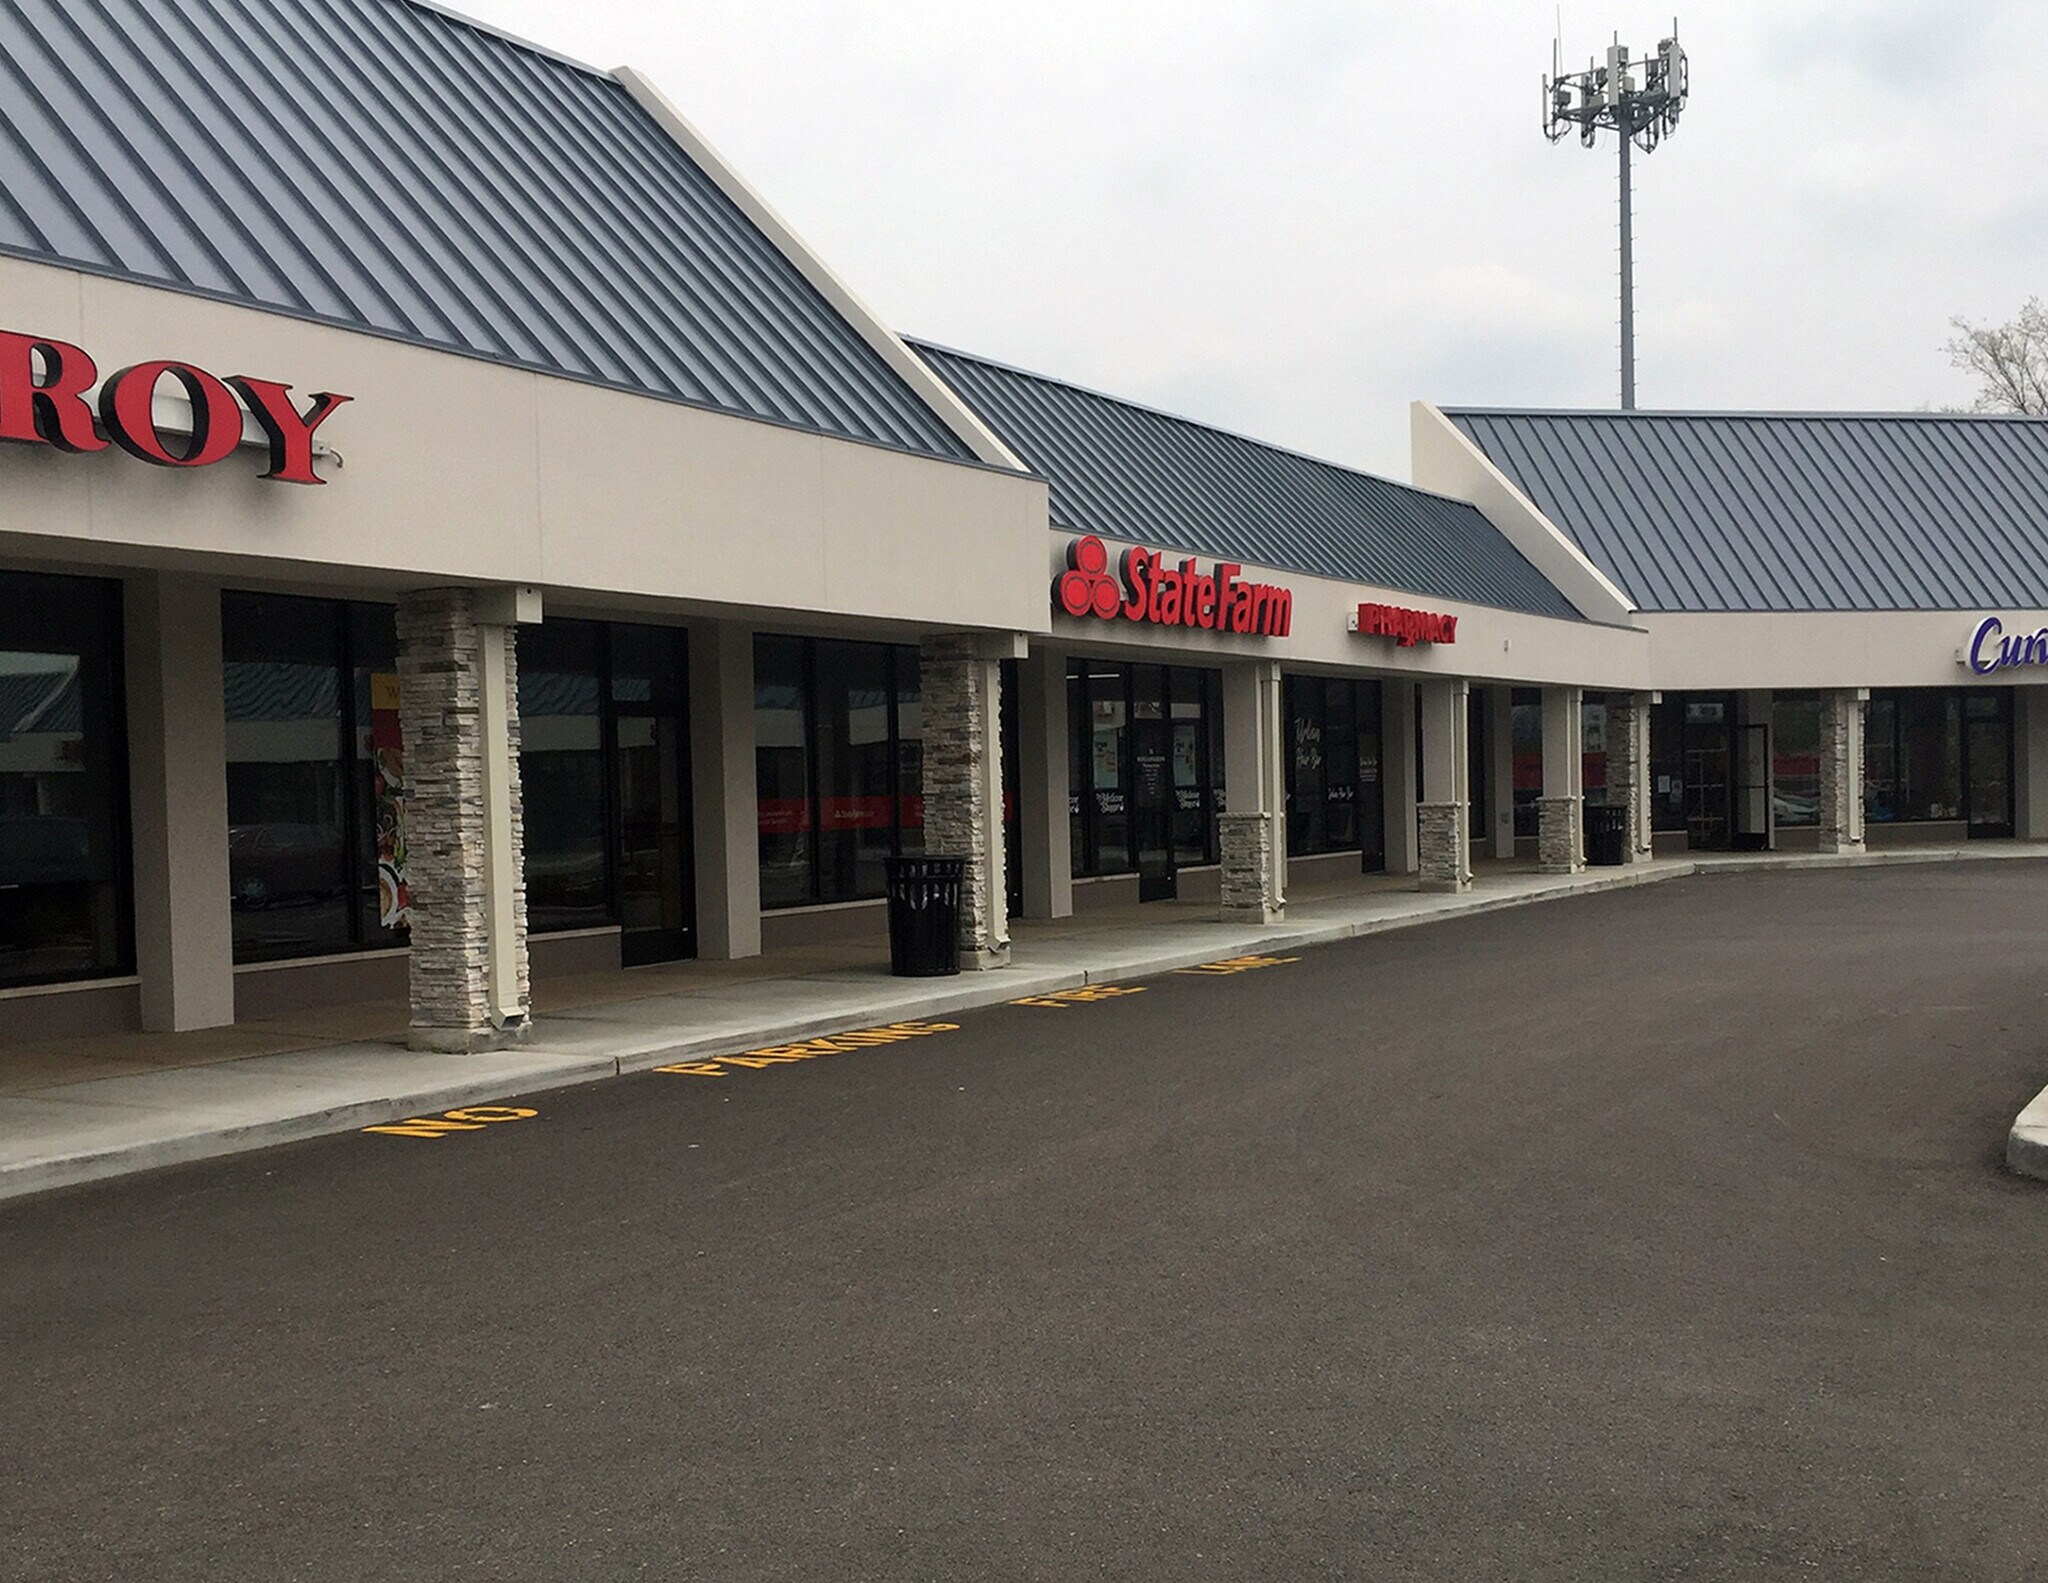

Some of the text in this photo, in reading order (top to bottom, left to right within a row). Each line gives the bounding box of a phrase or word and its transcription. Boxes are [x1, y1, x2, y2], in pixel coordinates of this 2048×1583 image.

[0, 331, 353, 485] ROY
[361, 1106, 539, 1138] NO
[653, 1022, 961, 1076] PARKING
